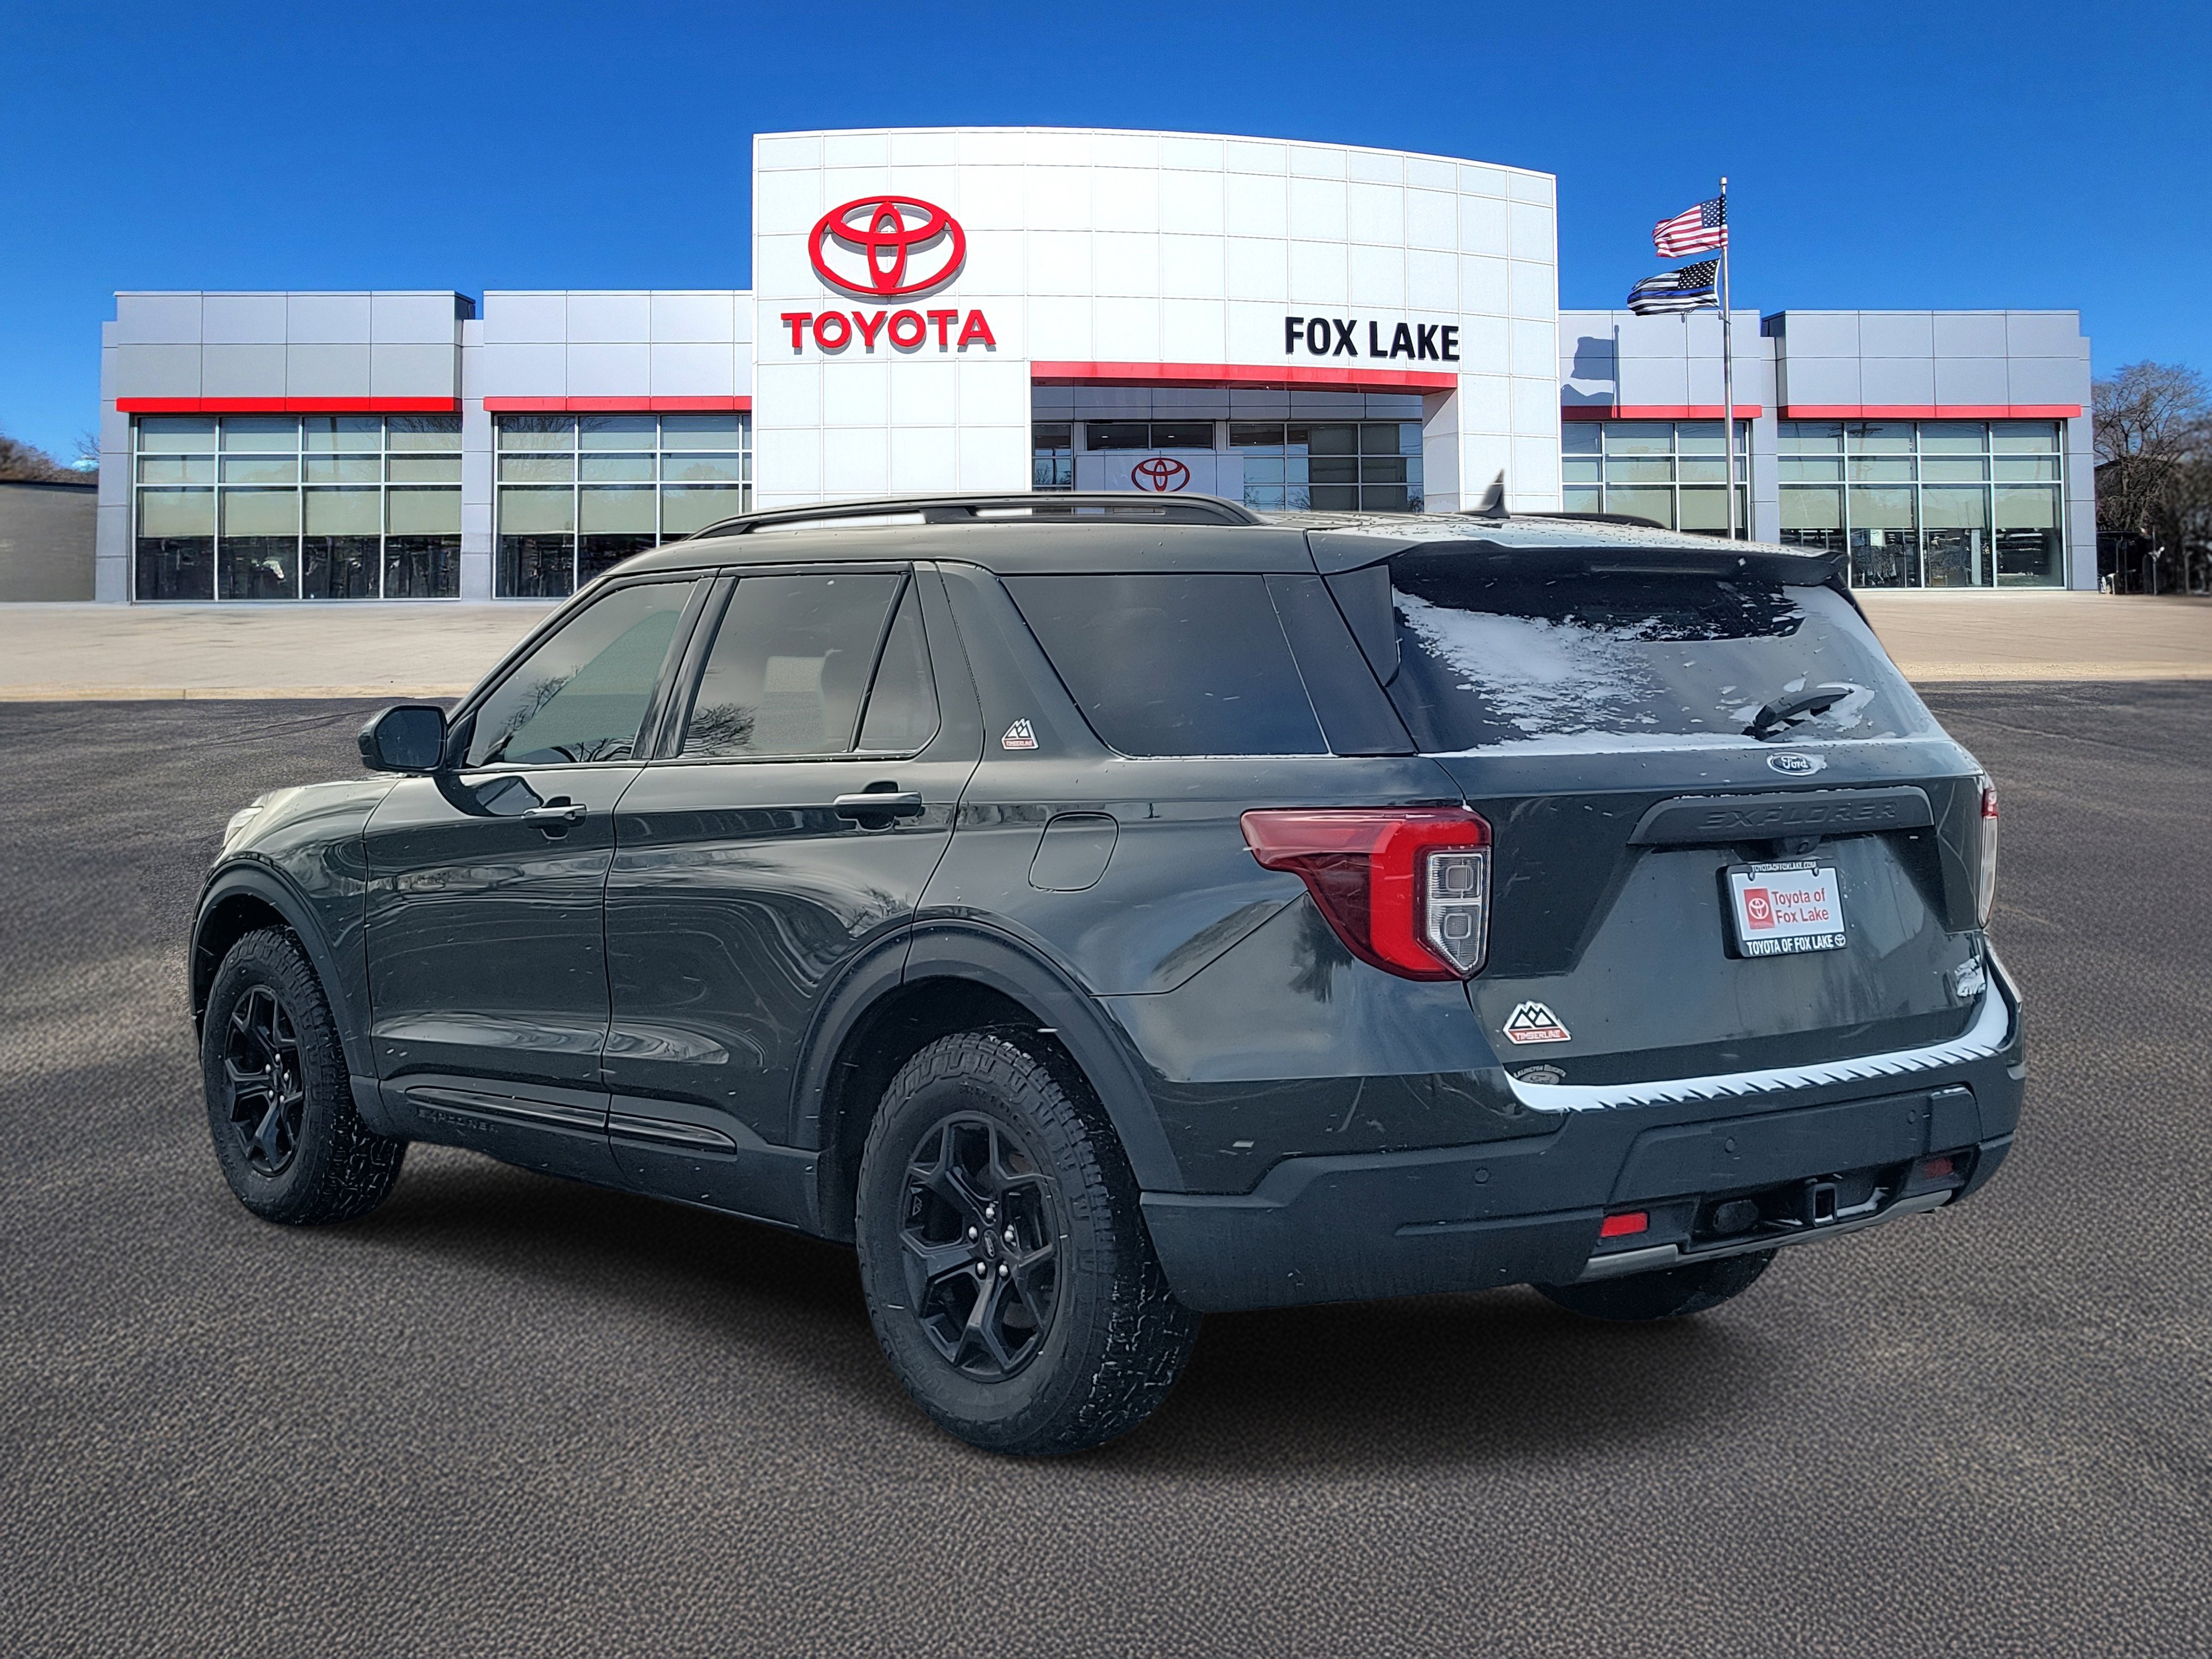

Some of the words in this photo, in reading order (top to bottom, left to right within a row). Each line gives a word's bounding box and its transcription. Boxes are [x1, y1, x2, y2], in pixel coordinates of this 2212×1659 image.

[781, 309, 997, 349] TOYOTA
[1285, 316, 1358, 356] FOX
[1368, 320, 1460, 360] LAKE
[1781, 756, 1809, 769] Ford
[1697, 801, 1897, 830] EXPLORER
[1771, 890, 1811, 908] Toyota
[1814, 888, 1826, 902] of
[1775, 909, 1799, 924] Fox
[1800, 907, 1829, 922] Lake
[1746, 938, 1782, 955] TOYOTA
[1781, 937, 1793, 952] OF
[1794, 936, 1812, 952] FOX
[1811, 934, 1835, 949] LAKE
